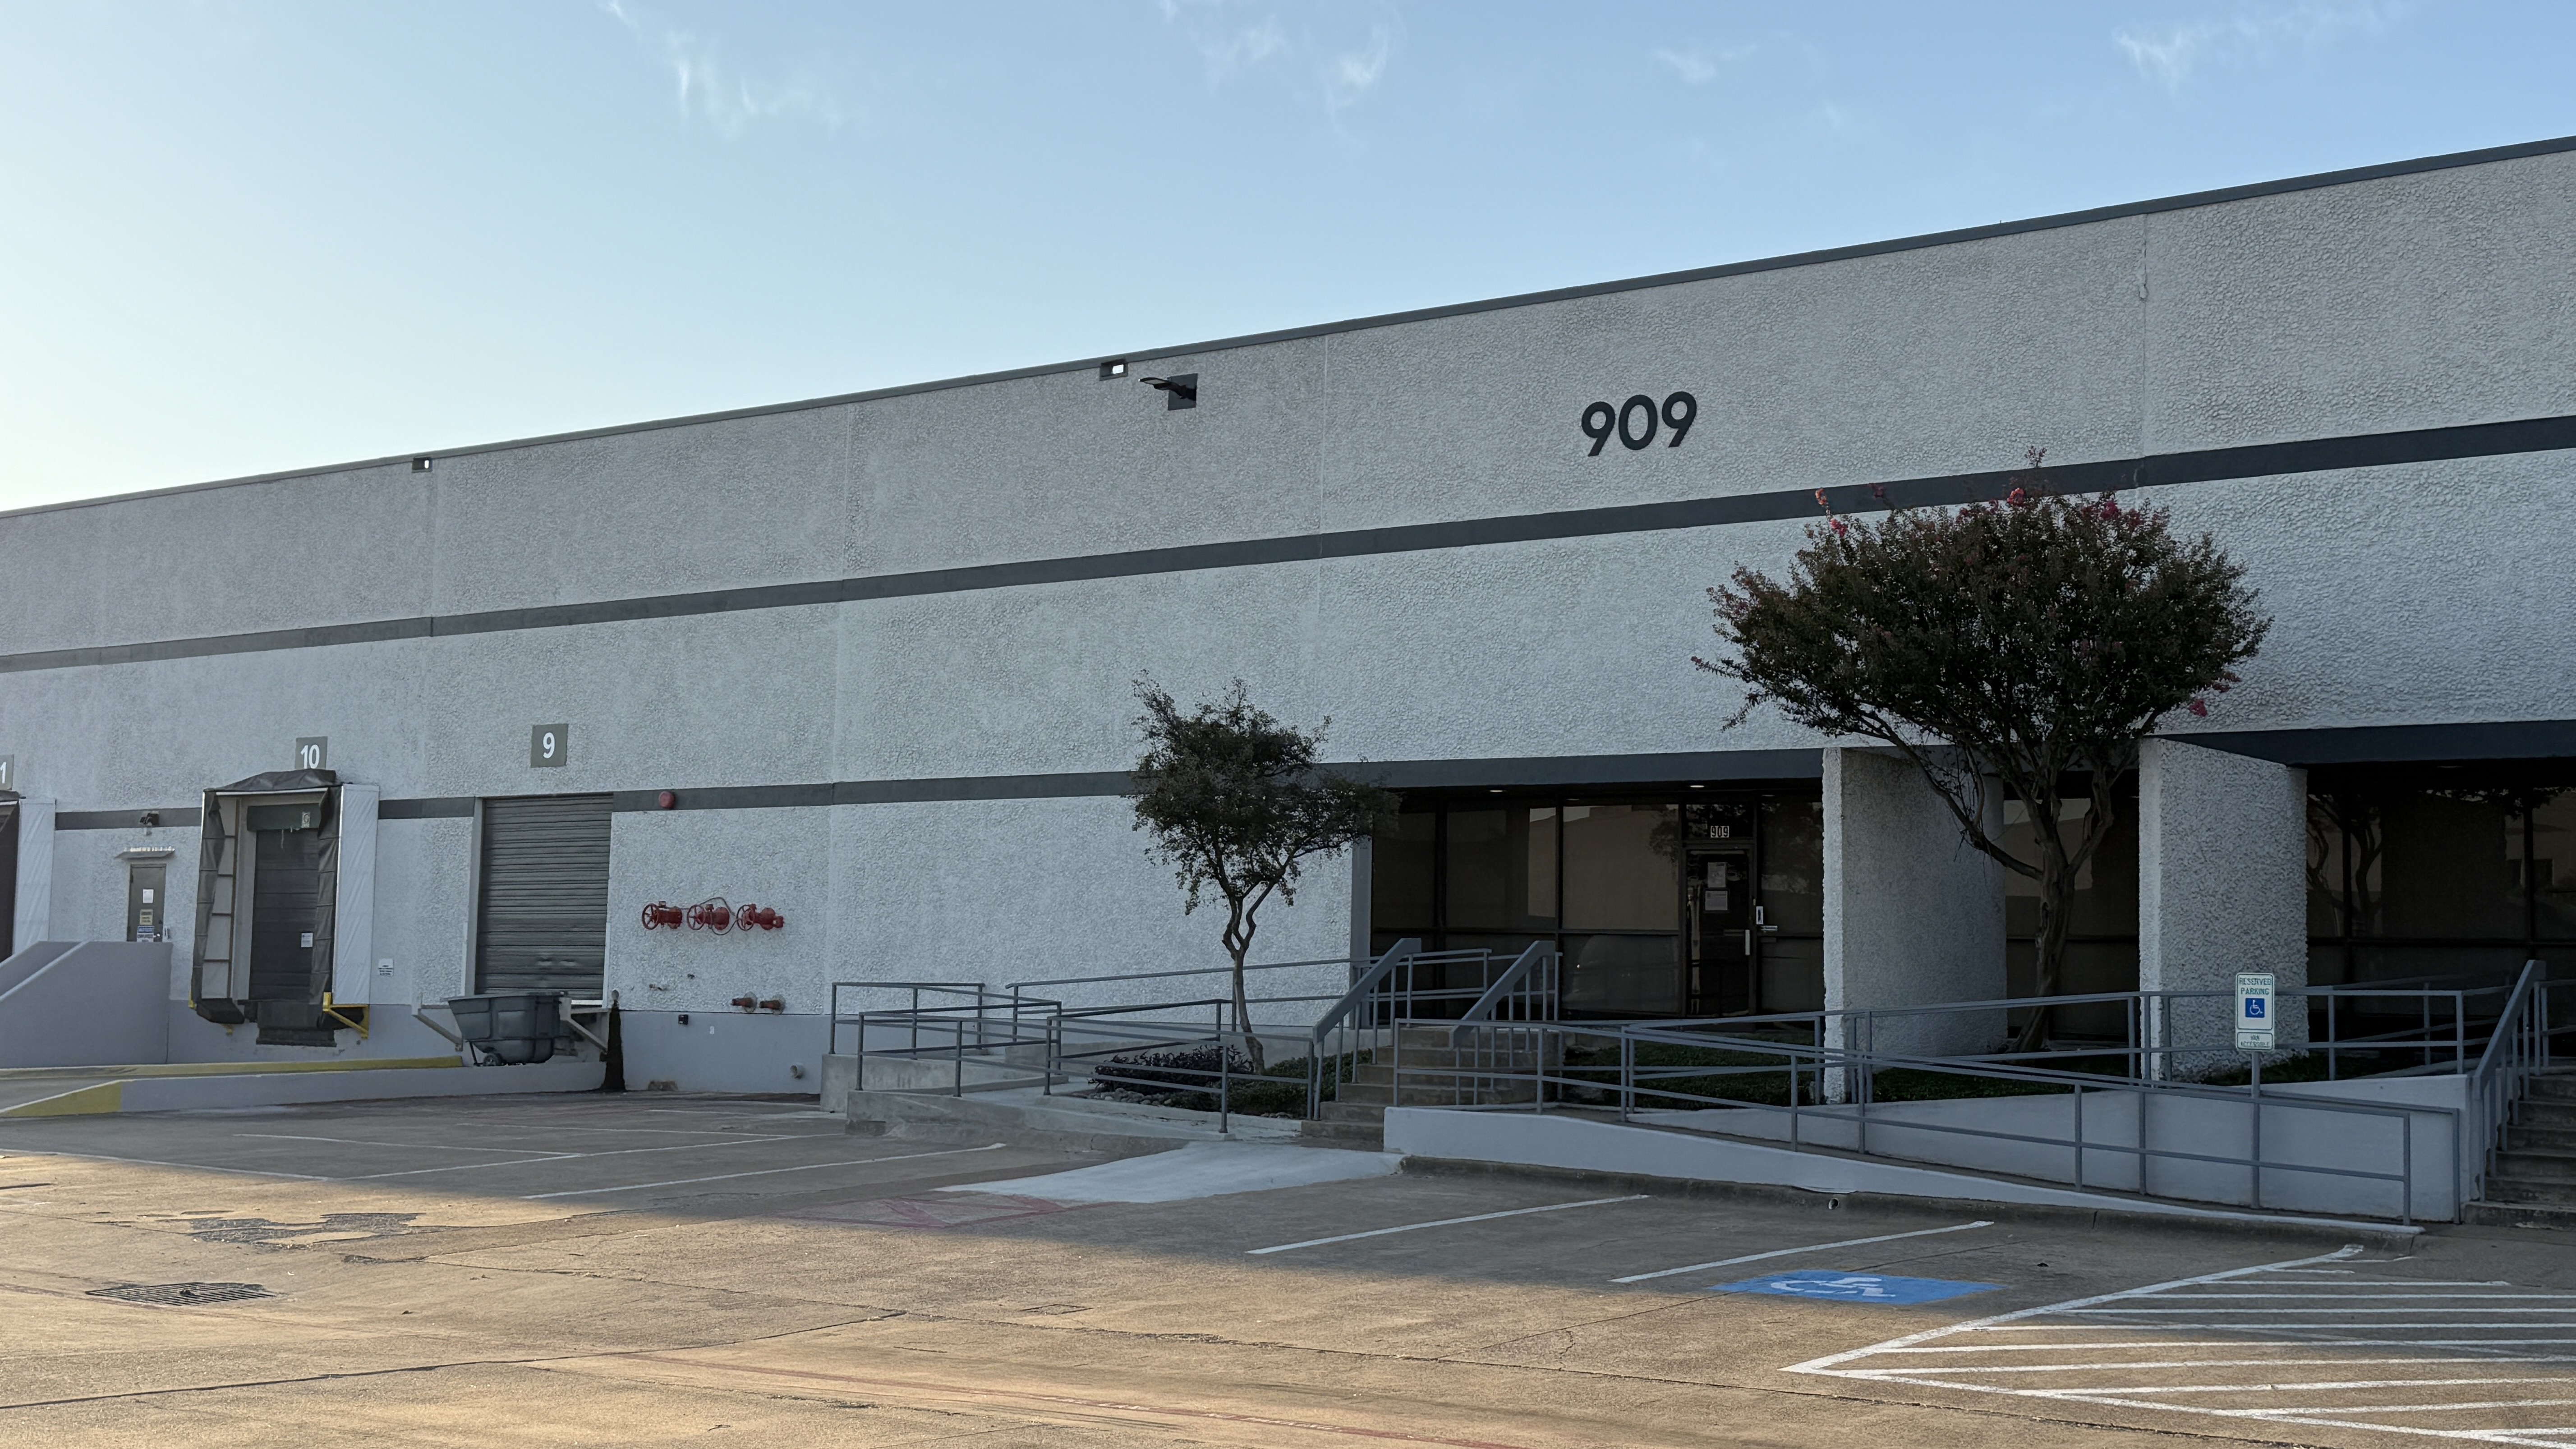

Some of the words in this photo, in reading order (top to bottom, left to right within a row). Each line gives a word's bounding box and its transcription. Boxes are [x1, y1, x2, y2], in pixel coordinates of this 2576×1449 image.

[1581, 391, 1697, 457] 909
[300, 744, 320, 769] 10
[543, 732, 555, 759] 9
[1711, 826, 1728, 837] 909
